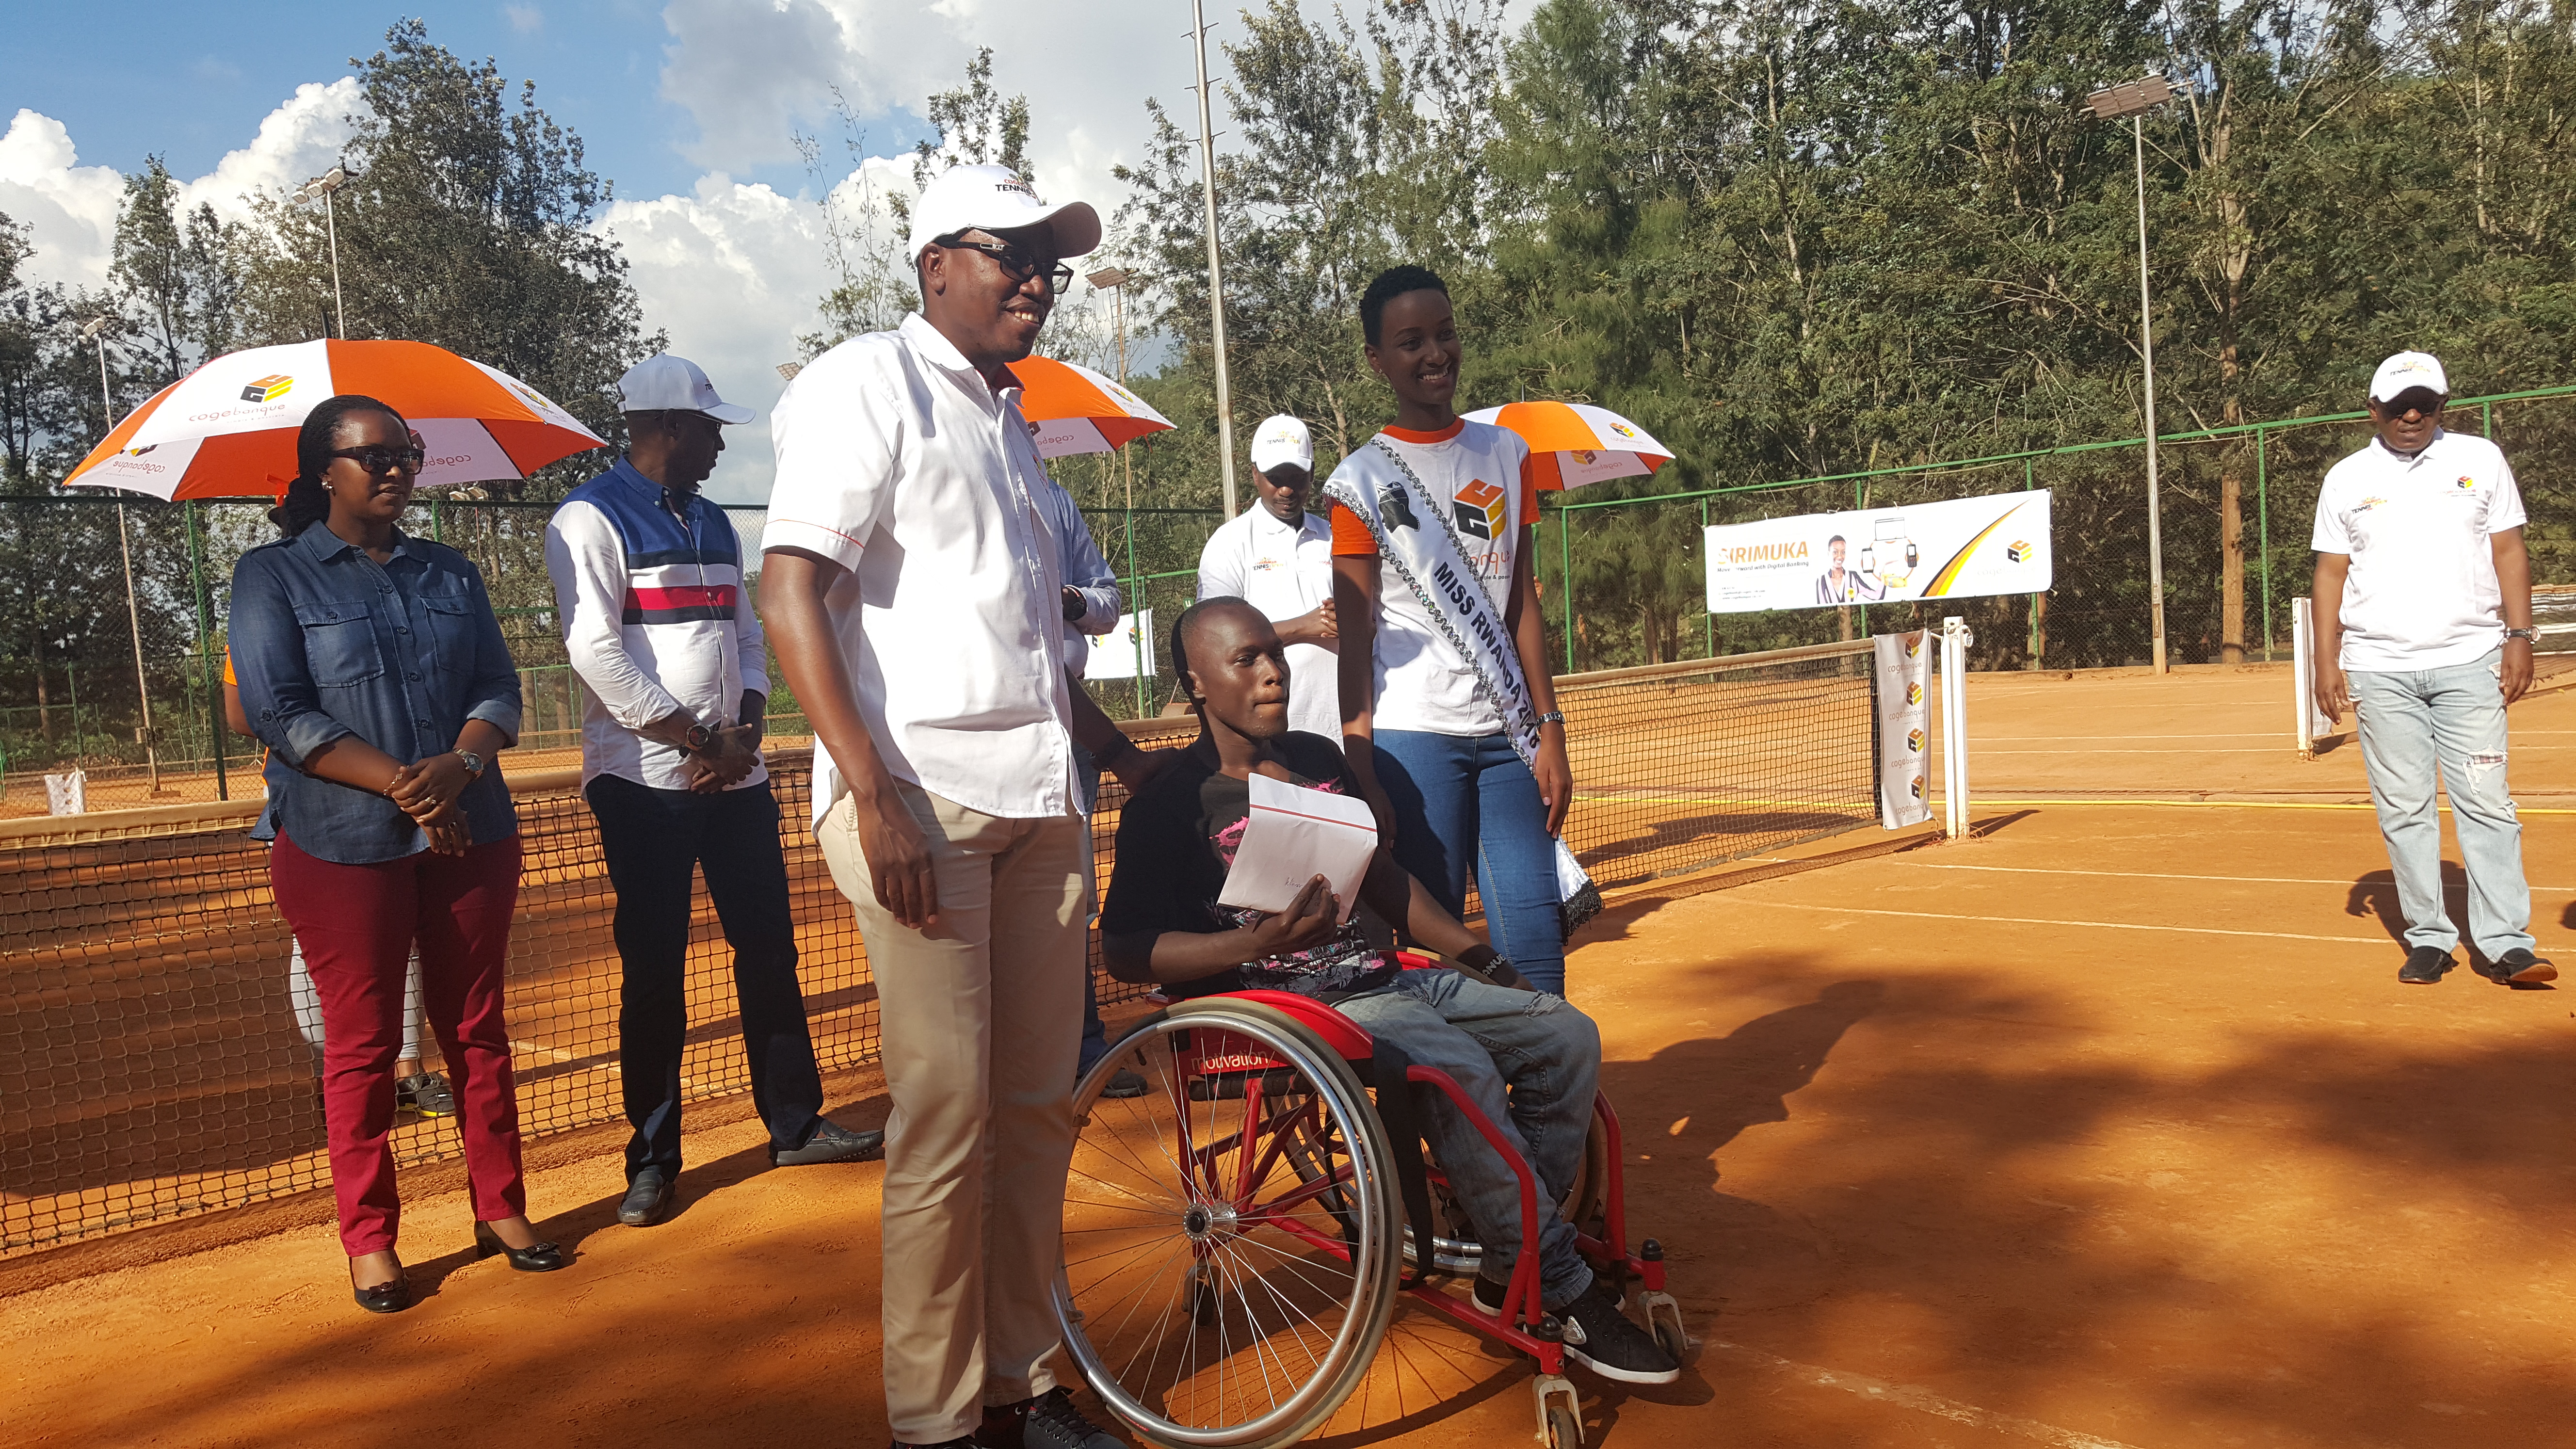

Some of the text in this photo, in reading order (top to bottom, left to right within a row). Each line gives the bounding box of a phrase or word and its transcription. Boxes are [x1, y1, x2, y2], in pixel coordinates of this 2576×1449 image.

[189, 404, 285, 421] cogebanque
[1718, 541, 1808, 564] SIRIMUKA
[1434, 561, 1475, 615] MISS
[1471, 611, 1521, 704] RWANDA
[1888, 660, 1922, 674] cogebanque
[1889, 708, 1925, 722] cogebanque
[1891, 755, 1923, 769] cogebanqu
[1191, 1050, 1268, 1071] motivation
